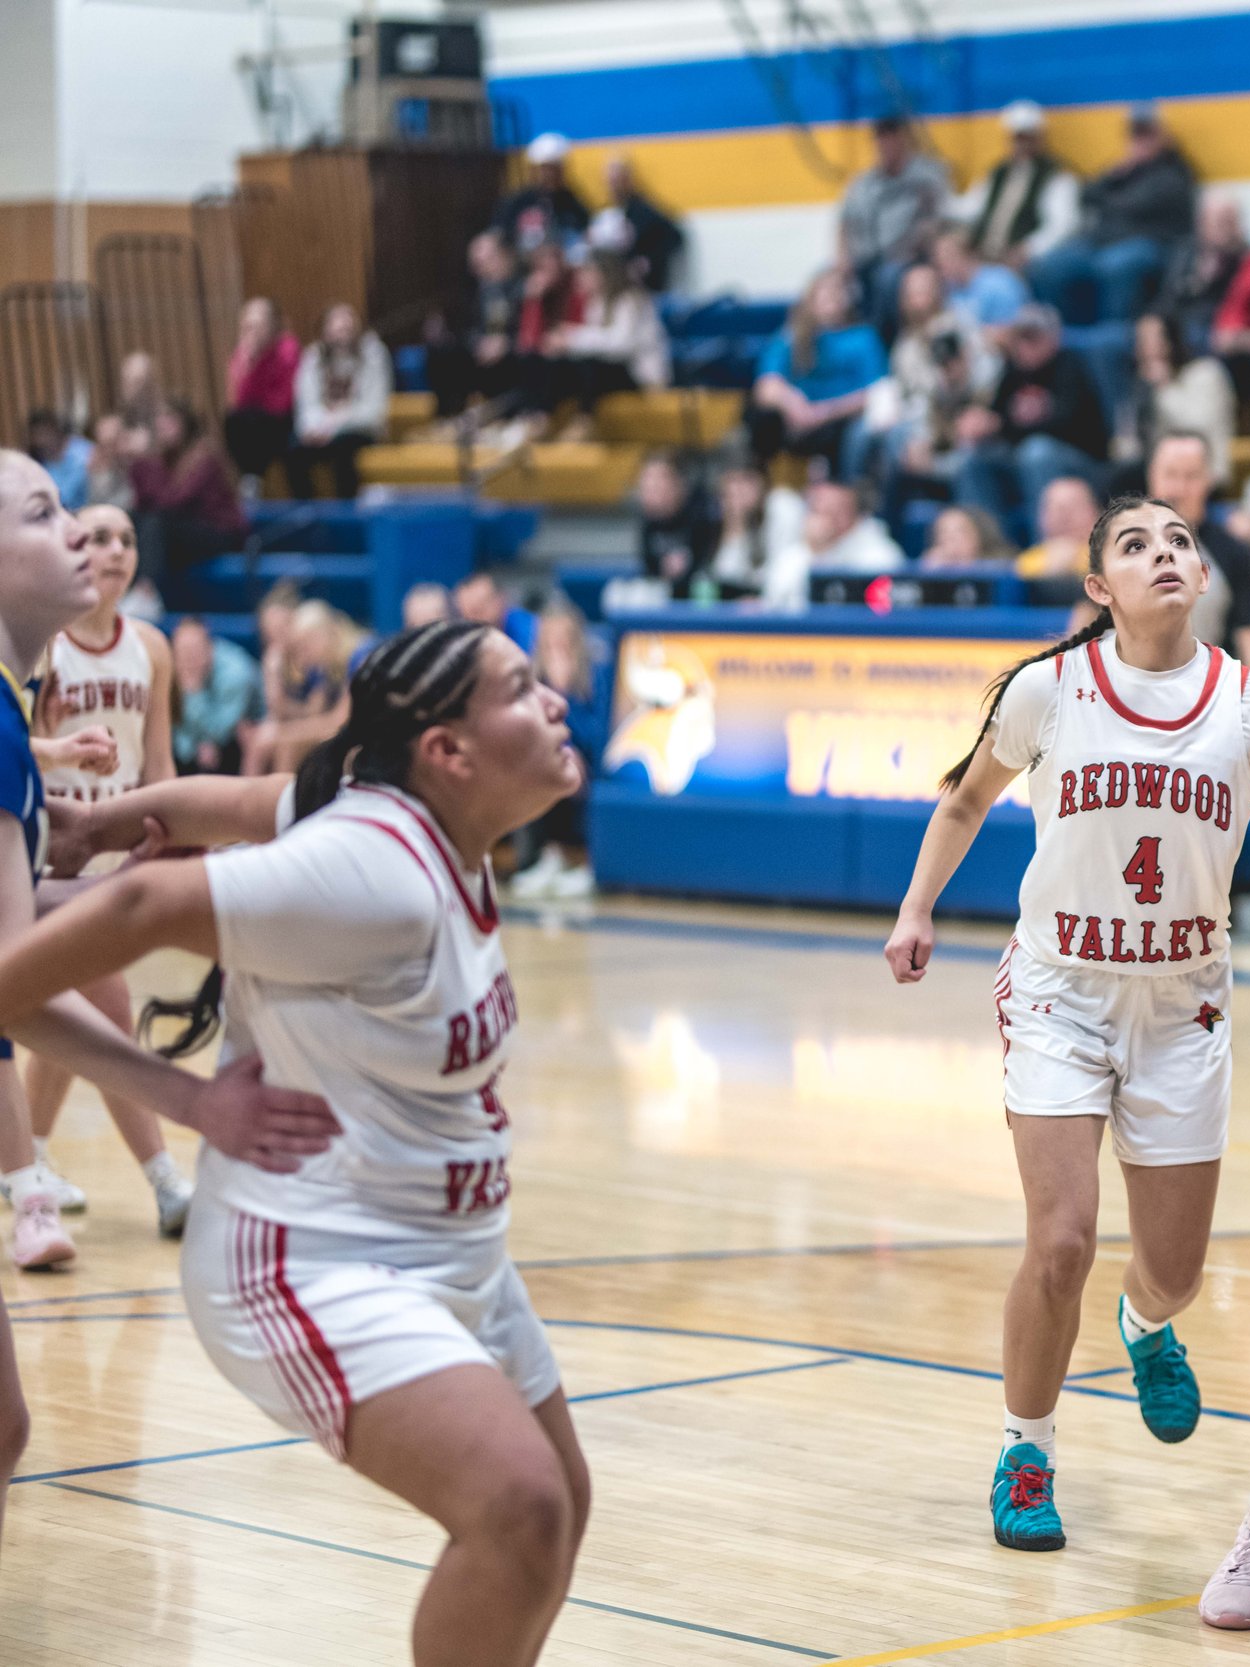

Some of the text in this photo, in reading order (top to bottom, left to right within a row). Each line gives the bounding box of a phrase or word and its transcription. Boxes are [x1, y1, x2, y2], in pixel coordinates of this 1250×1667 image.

[1058, 761, 1232, 832] REDWOOD
[1122, 835, 1164, 904] 4
[1055, 911, 1217, 963] VALLEY
